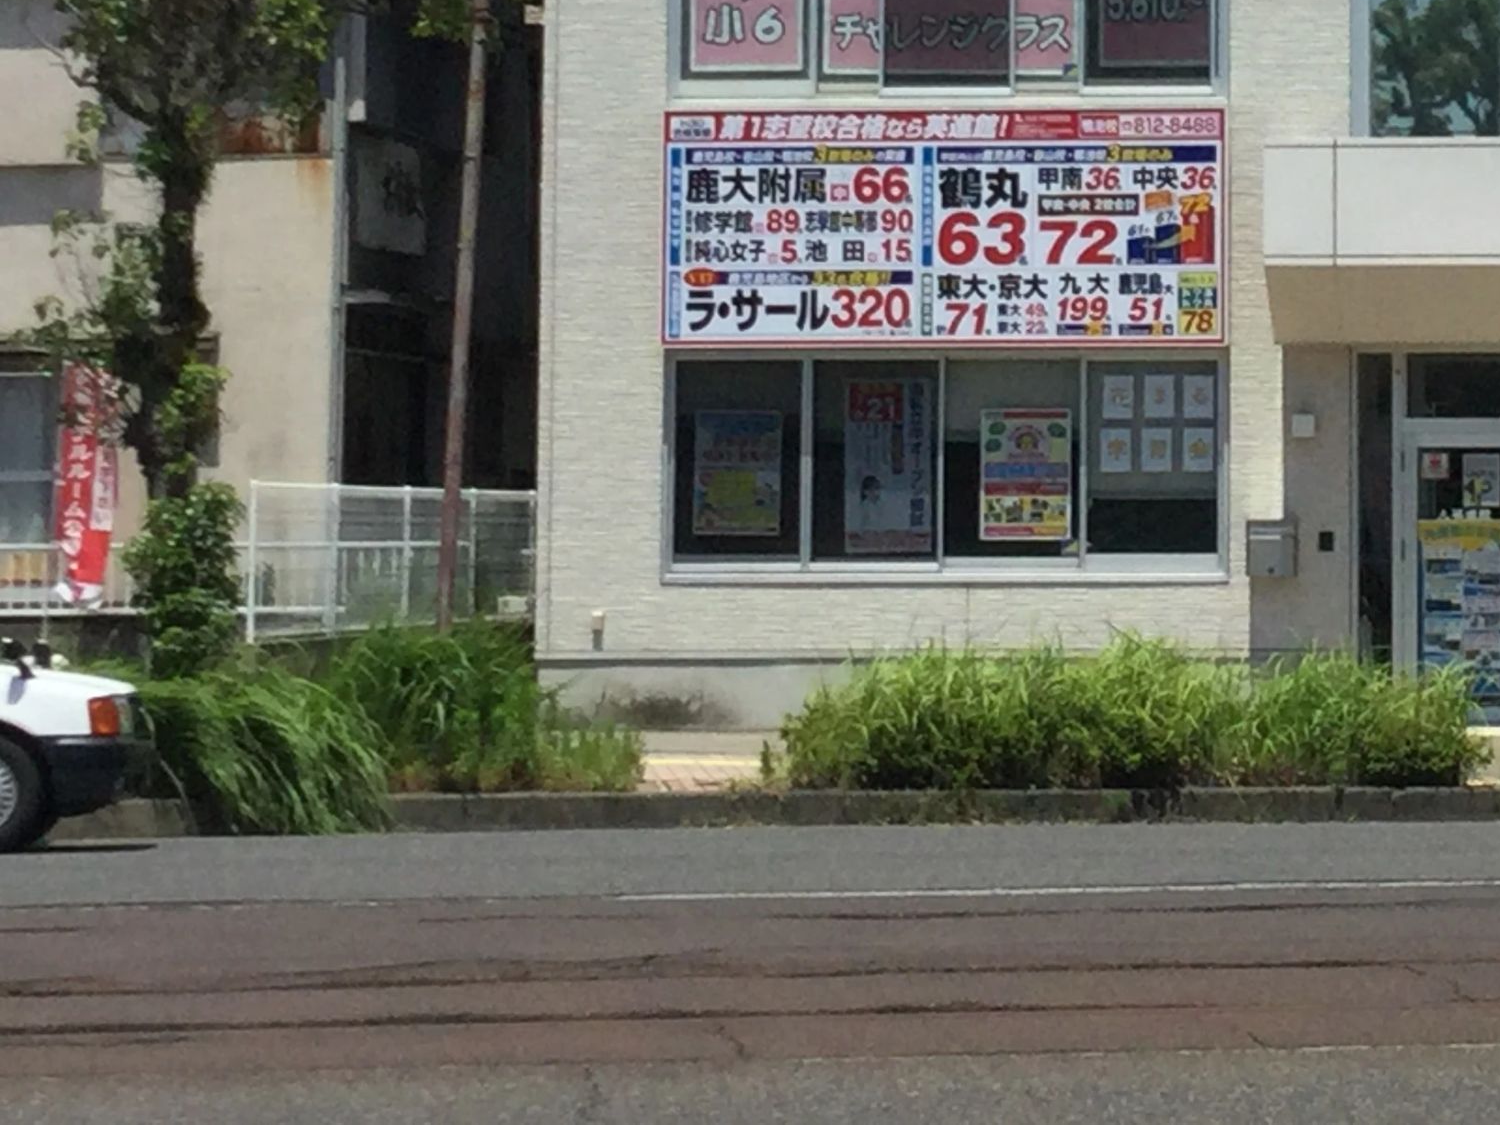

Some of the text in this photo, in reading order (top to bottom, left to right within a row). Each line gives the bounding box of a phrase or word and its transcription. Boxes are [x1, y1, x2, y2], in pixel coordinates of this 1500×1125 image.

[702, 3, 787, 45] 小6
[686, 167, 827, 205] 鹿大附属
[854, 166, 910, 205] 66
[939, 167, 1029, 210] 鶴丸
[1038, 166, 1083, 191] 甲南
[1133, 166, 1179, 191] 中央
[938, 211, 1026, 266] 63
[1038, 220, 1119, 266] 72
[937, 273, 1049, 300] 東大・京大
[1059, 273, 1110, 295] 九大
[685, 289, 831, 332] ラ・サール
[831, 287, 911, 329] 320
